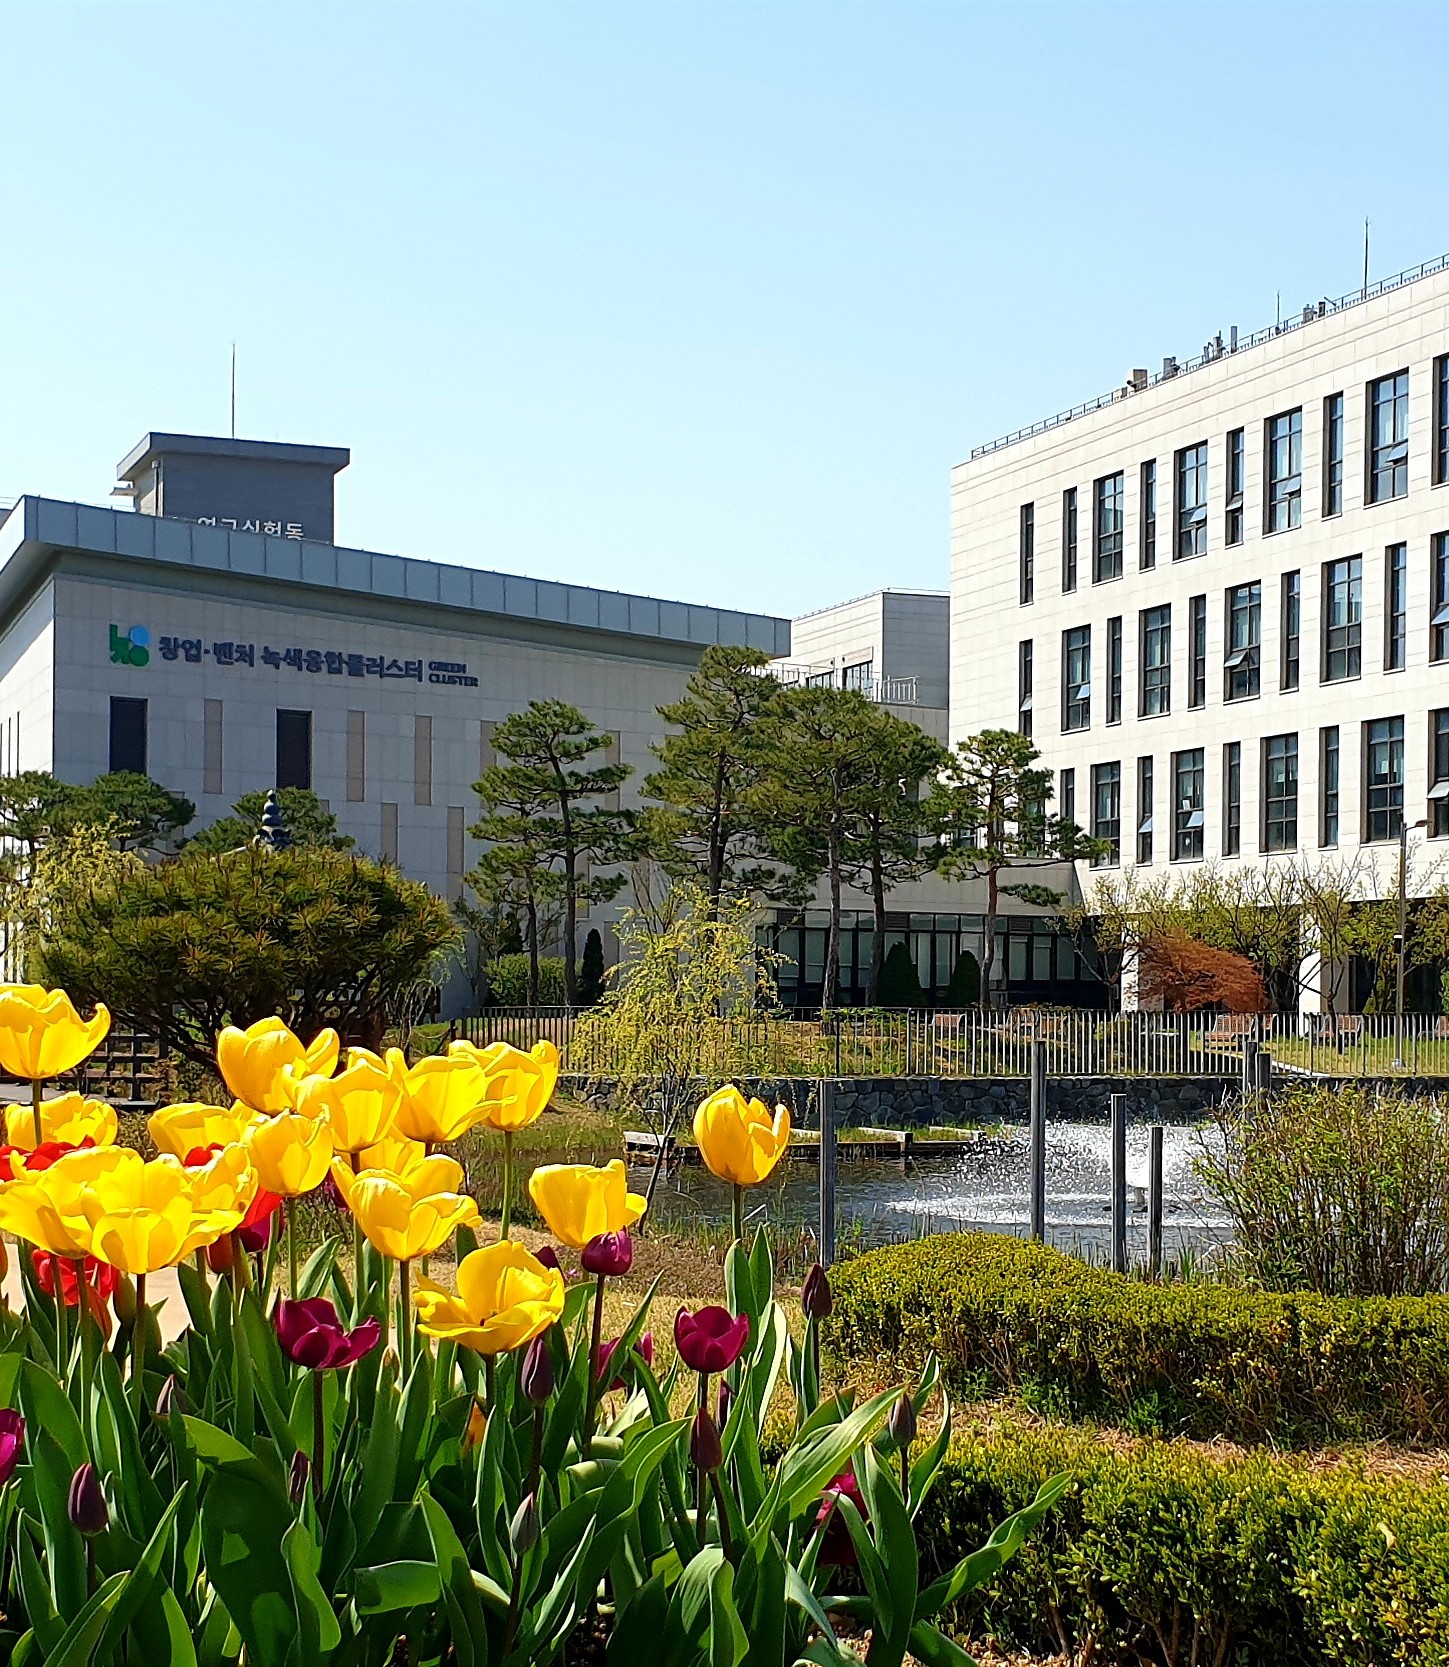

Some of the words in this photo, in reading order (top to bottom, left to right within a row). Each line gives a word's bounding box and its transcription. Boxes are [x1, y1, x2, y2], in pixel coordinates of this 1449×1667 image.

[158, 635, 255, 668] 창업·벤처
[260, 645, 424, 683] 녹색융합클러스터
[427, 673, 479, 687] CLUSTER
